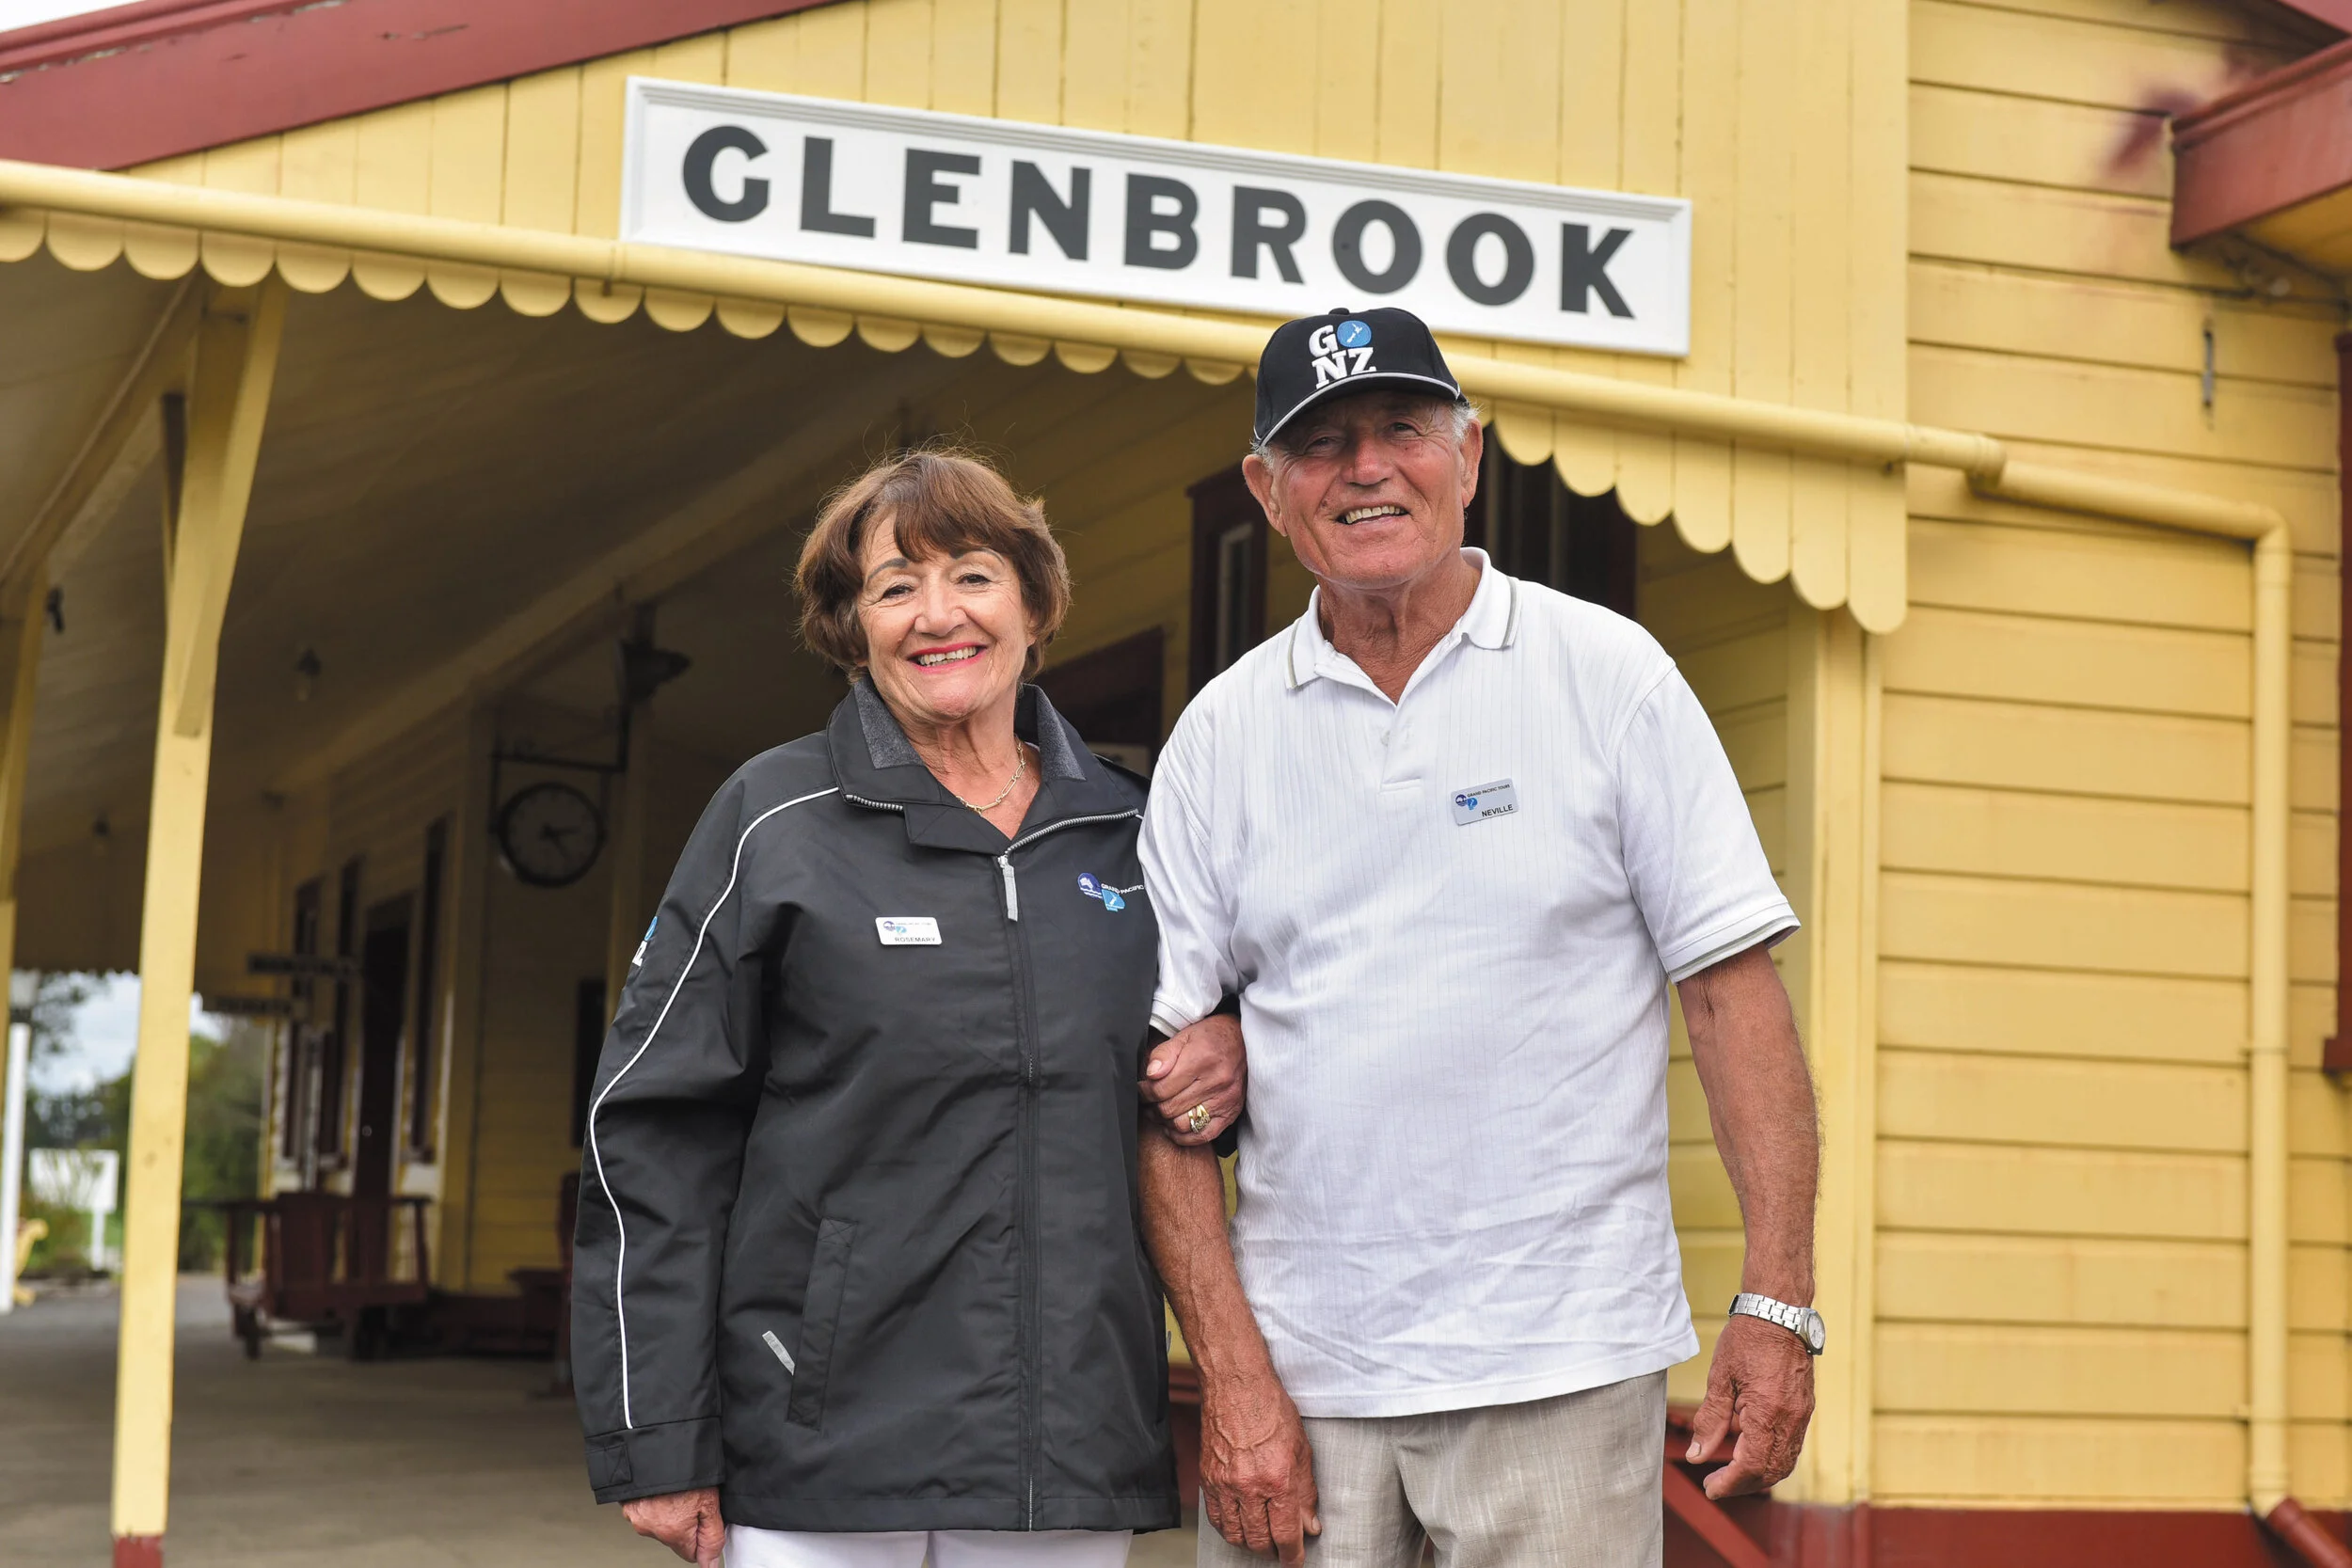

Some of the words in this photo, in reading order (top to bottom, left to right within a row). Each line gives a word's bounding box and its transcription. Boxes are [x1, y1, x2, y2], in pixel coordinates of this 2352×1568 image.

[683, 125, 1634, 318] GLENBROOK
[1311, 347, 1377, 389] NZ
[1481, 804, 1514, 817] NEVILLE
[1120, 884, 1145, 895] PACIFIC
